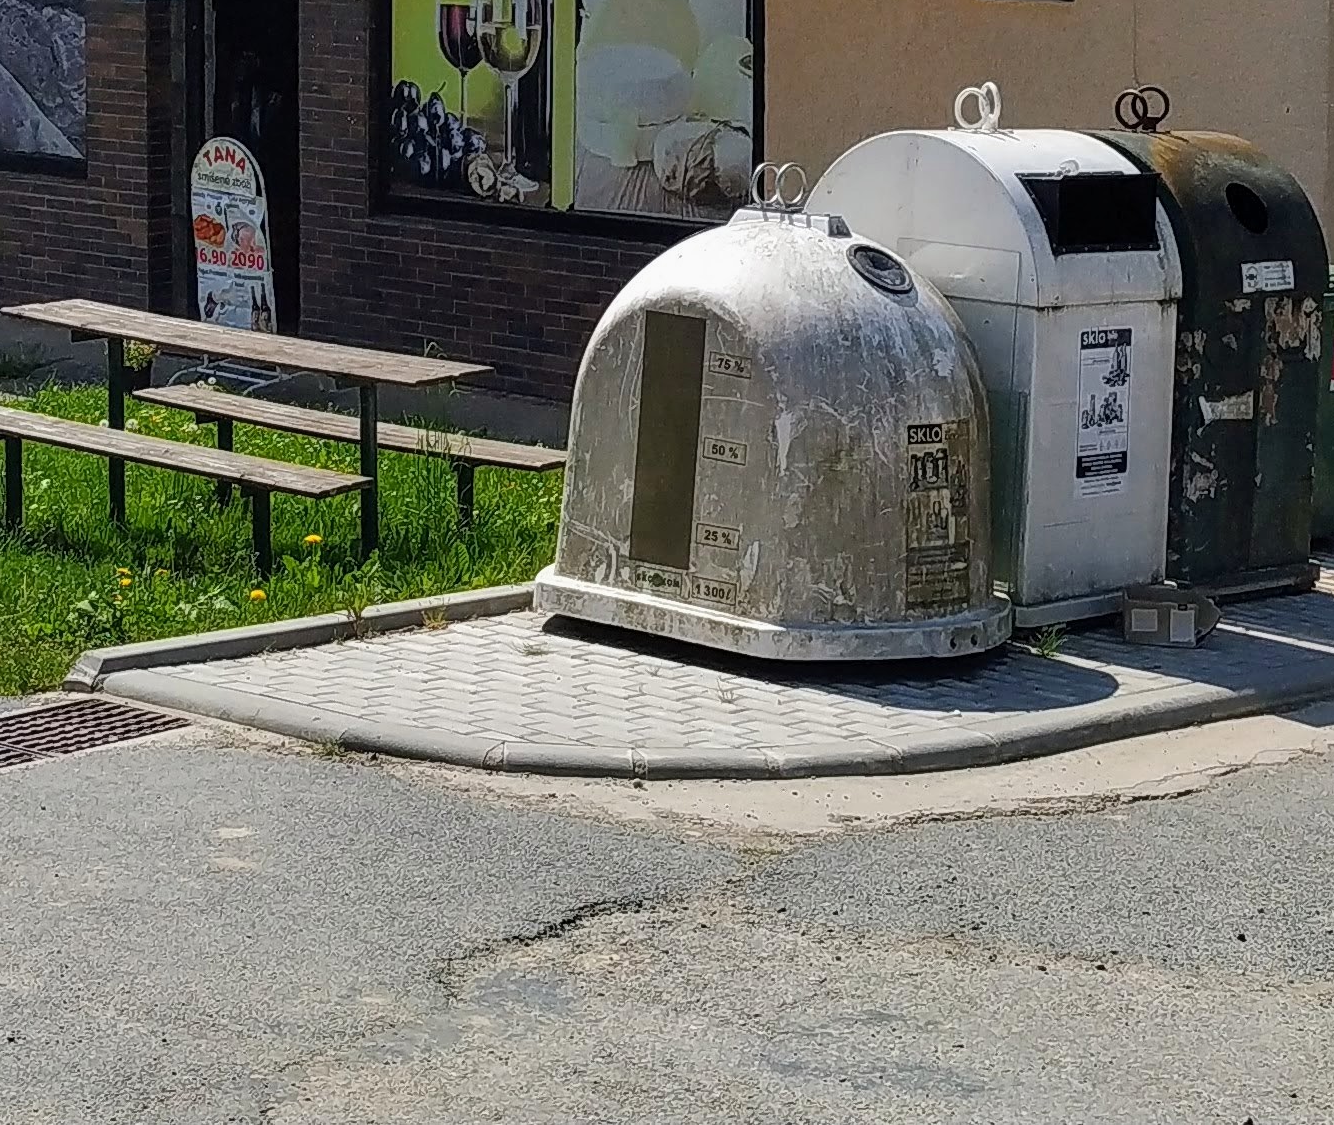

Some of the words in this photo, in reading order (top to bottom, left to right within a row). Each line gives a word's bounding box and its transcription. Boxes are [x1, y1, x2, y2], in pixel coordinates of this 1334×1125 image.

[202, 145, 247, 175] TANA
[1082, 327, 1106, 346] sklo
[717, 357, 732, 371] 75
[909, 426, 942, 443] SKLO
[711, 443, 726, 456] 50
[703, 529, 719, 542] 25
